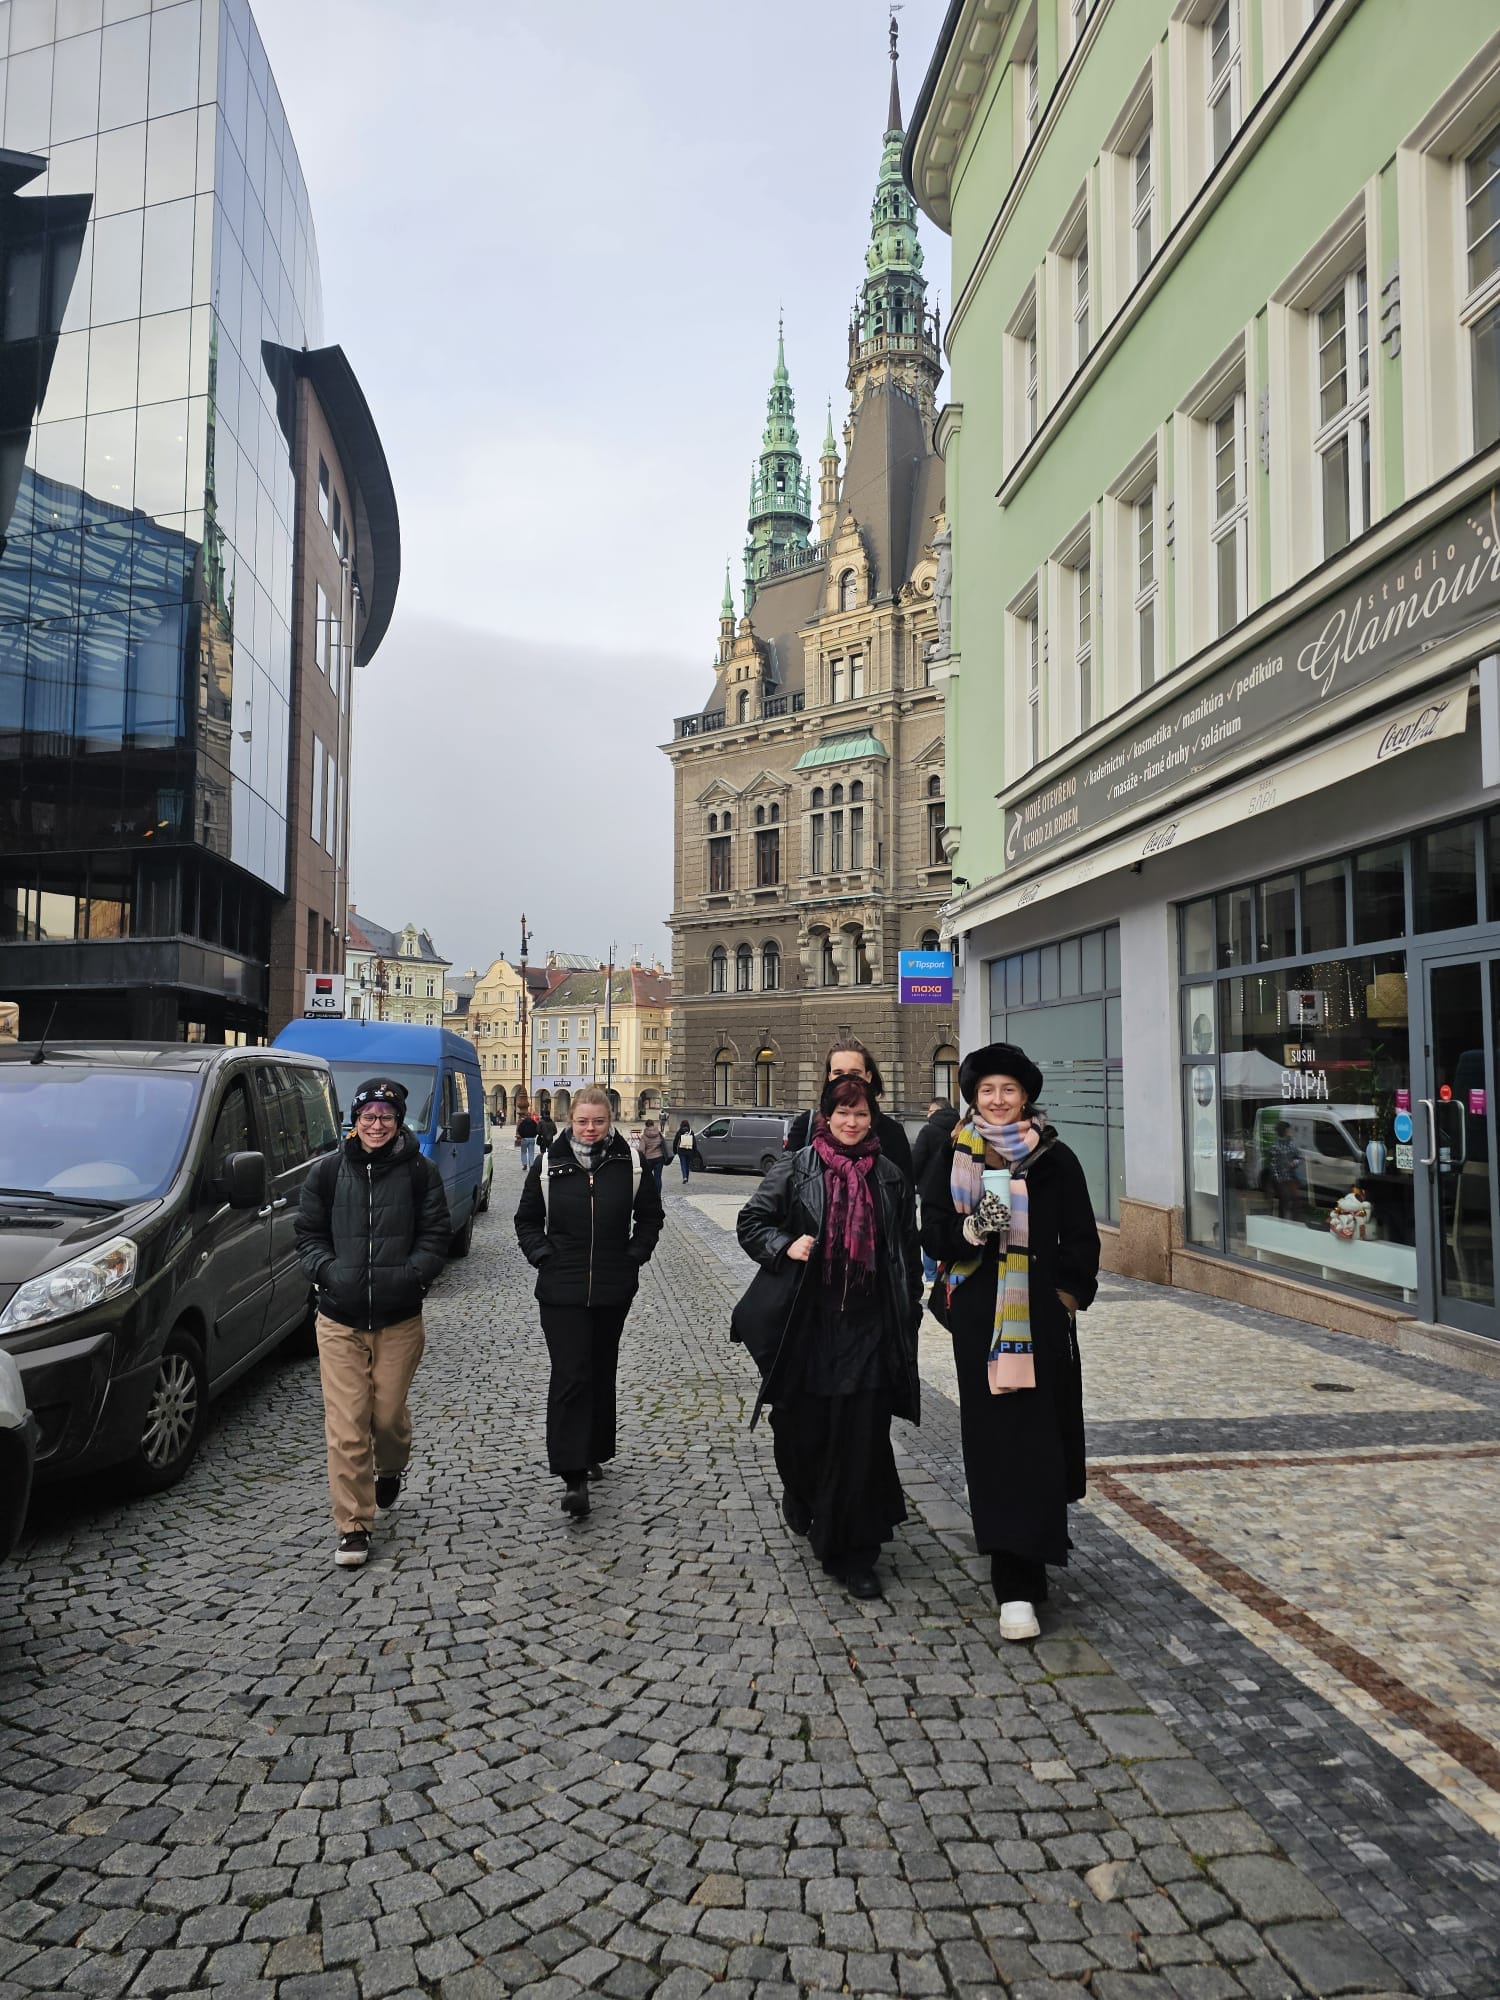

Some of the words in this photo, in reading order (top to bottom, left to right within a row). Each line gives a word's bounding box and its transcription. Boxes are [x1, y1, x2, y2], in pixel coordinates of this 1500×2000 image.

[1367, 544, 1456, 610] studio
[1089, 748, 1126, 785] kadeřnictví
[1133, 724, 1172, 759] kosmetika
[1182, 693, 1224, 730] manikúra
[1236, 656, 1283, 702] pedikúra
[1113, 772, 1138, 799] masáže
[1143, 761, 1165, 782] různé
[1166, 744, 1190, 769] druhy
[1200, 716, 1241, 751] solárium
[1025, 795, 1041, 824] NOVĚ
[1041, 777, 1077, 813] OTEVŘENO
[1023, 826, 1044, 852] VCHOD
[1044, 820, 1053, 841] ZA
[1053, 806, 1078, 836] ROHEM
[915, 960, 945, 970] Tipsport
[311, 998, 336, 1008] KB
[911, 985, 942, 993] maxa
[1291, 1049, 1316, 1063] SUSHI
[1281, 1069, 1329, 1100] SAPA
